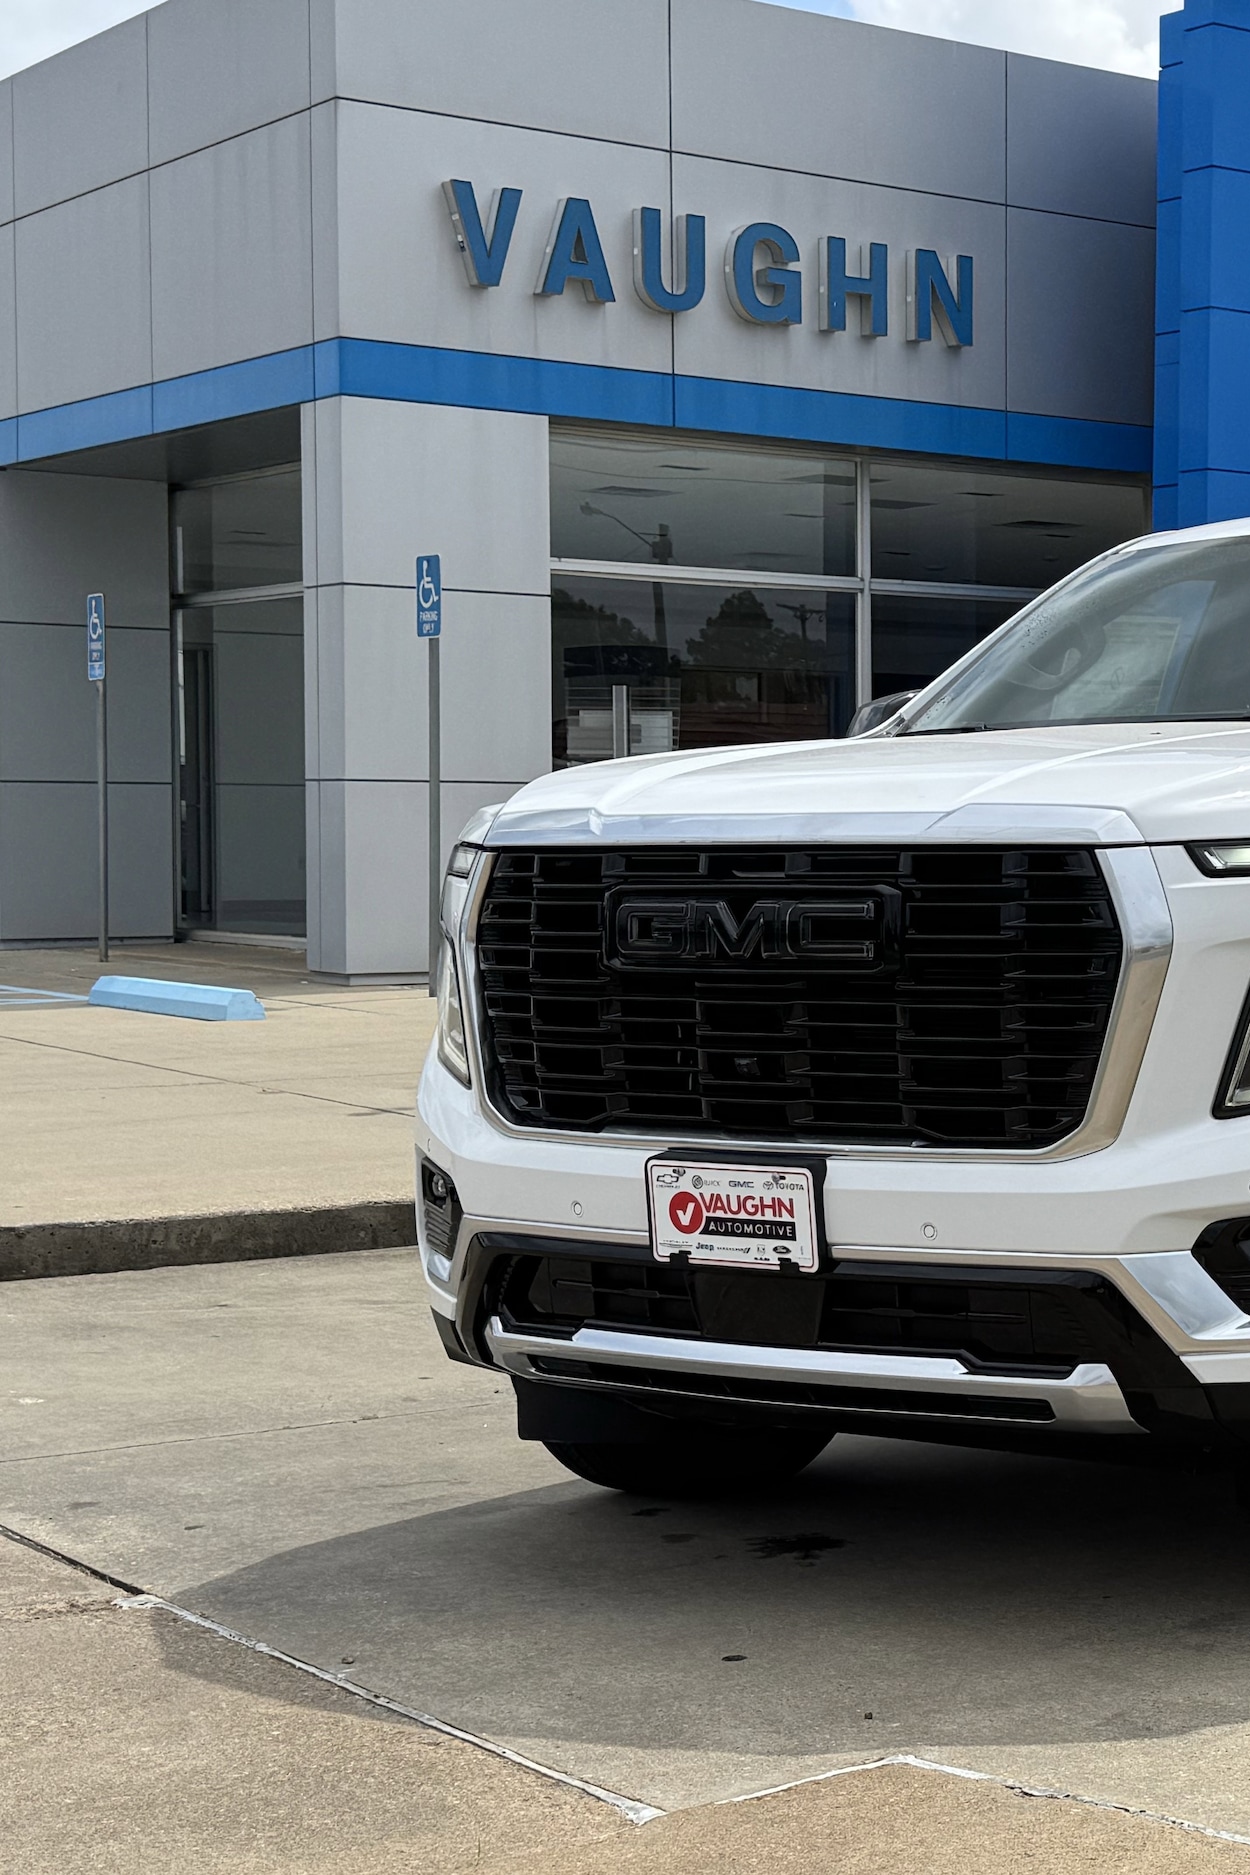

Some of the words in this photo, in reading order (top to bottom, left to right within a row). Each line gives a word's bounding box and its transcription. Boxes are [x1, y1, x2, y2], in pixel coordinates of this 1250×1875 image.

[441, 179, 974, 348] VAUGHN
[616, 900, 875, 960] GMC
[728, 1180, 755, 1189] GMC
[775, 1182, 804, 1191] TOYOTA
[699, 1192, 795, 1219] VAUGHN
[708, 1221, 793, 1237] AUTOMOTIVE
